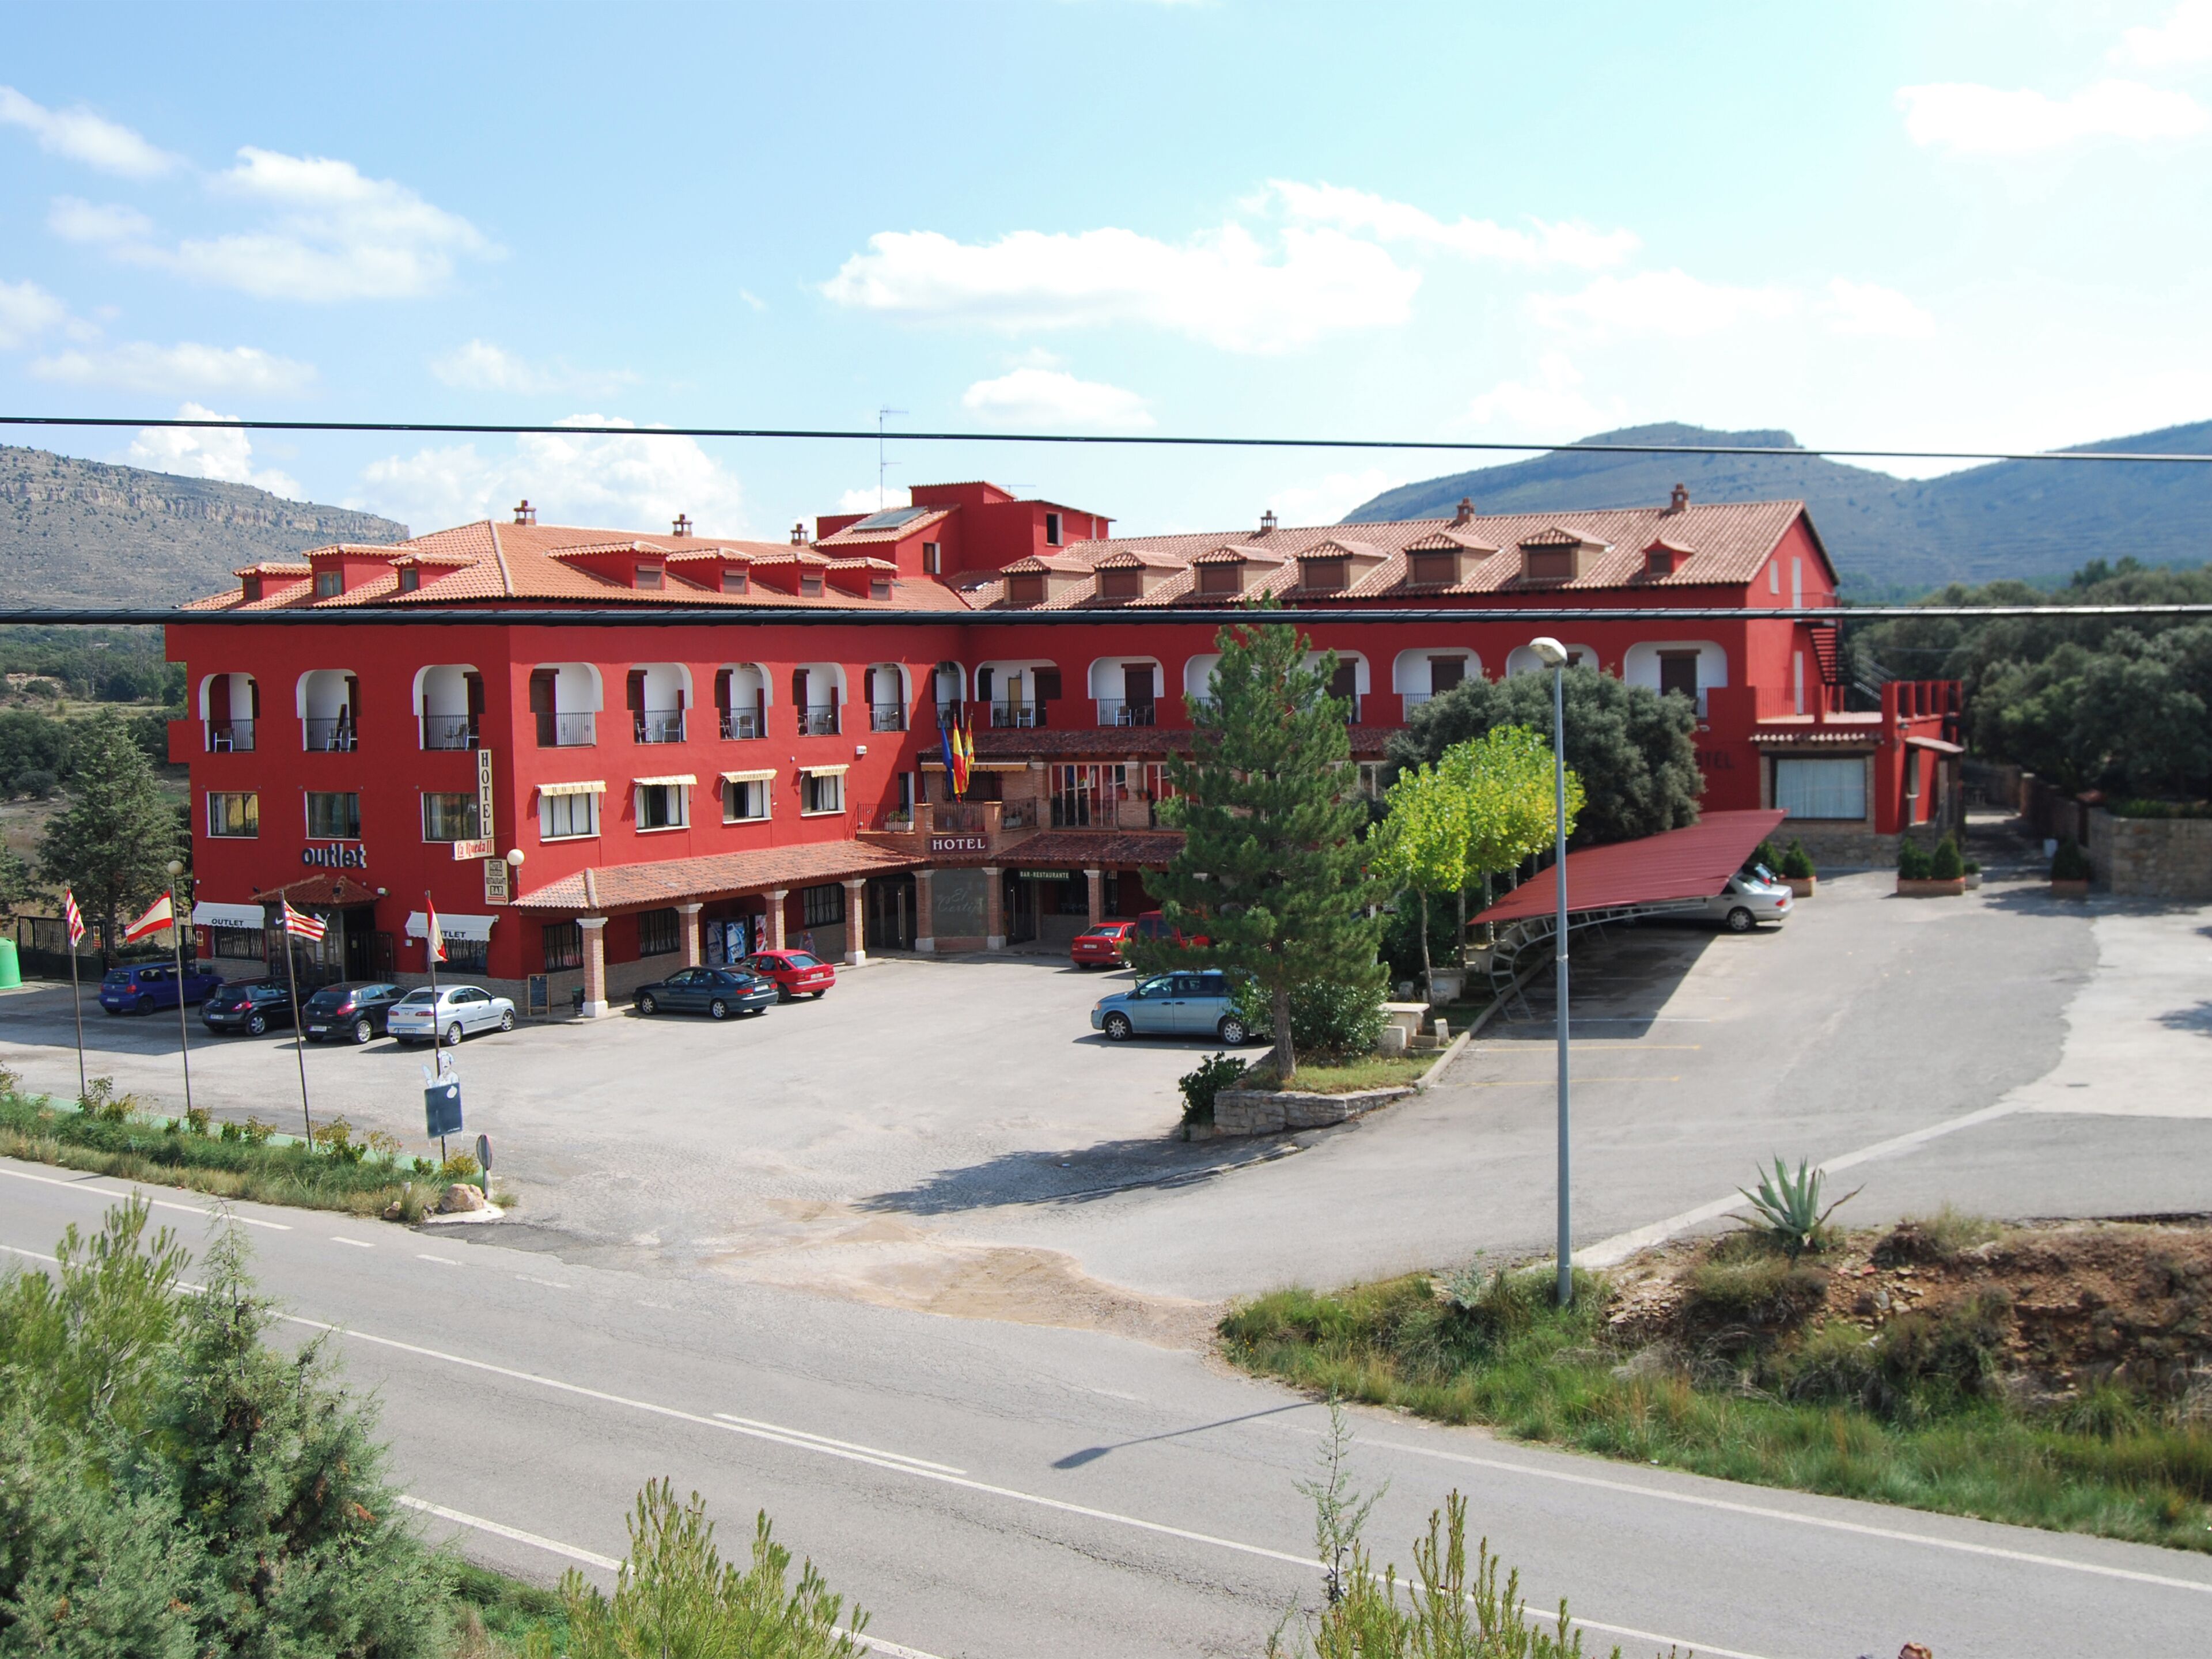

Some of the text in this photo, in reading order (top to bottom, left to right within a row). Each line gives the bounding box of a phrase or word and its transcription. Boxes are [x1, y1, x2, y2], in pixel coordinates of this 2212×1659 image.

[481, 752, 490, 835] HOTEL
[466, 840, 486, 857] Rueda
[933, 838, 986, 850] HOTEL
[302, 843, 368, 869] outlet
[490, 886, 503, 895] BAR
[951, 888, 967, 903] El
[211, 918, 244, 926] OUTLET
